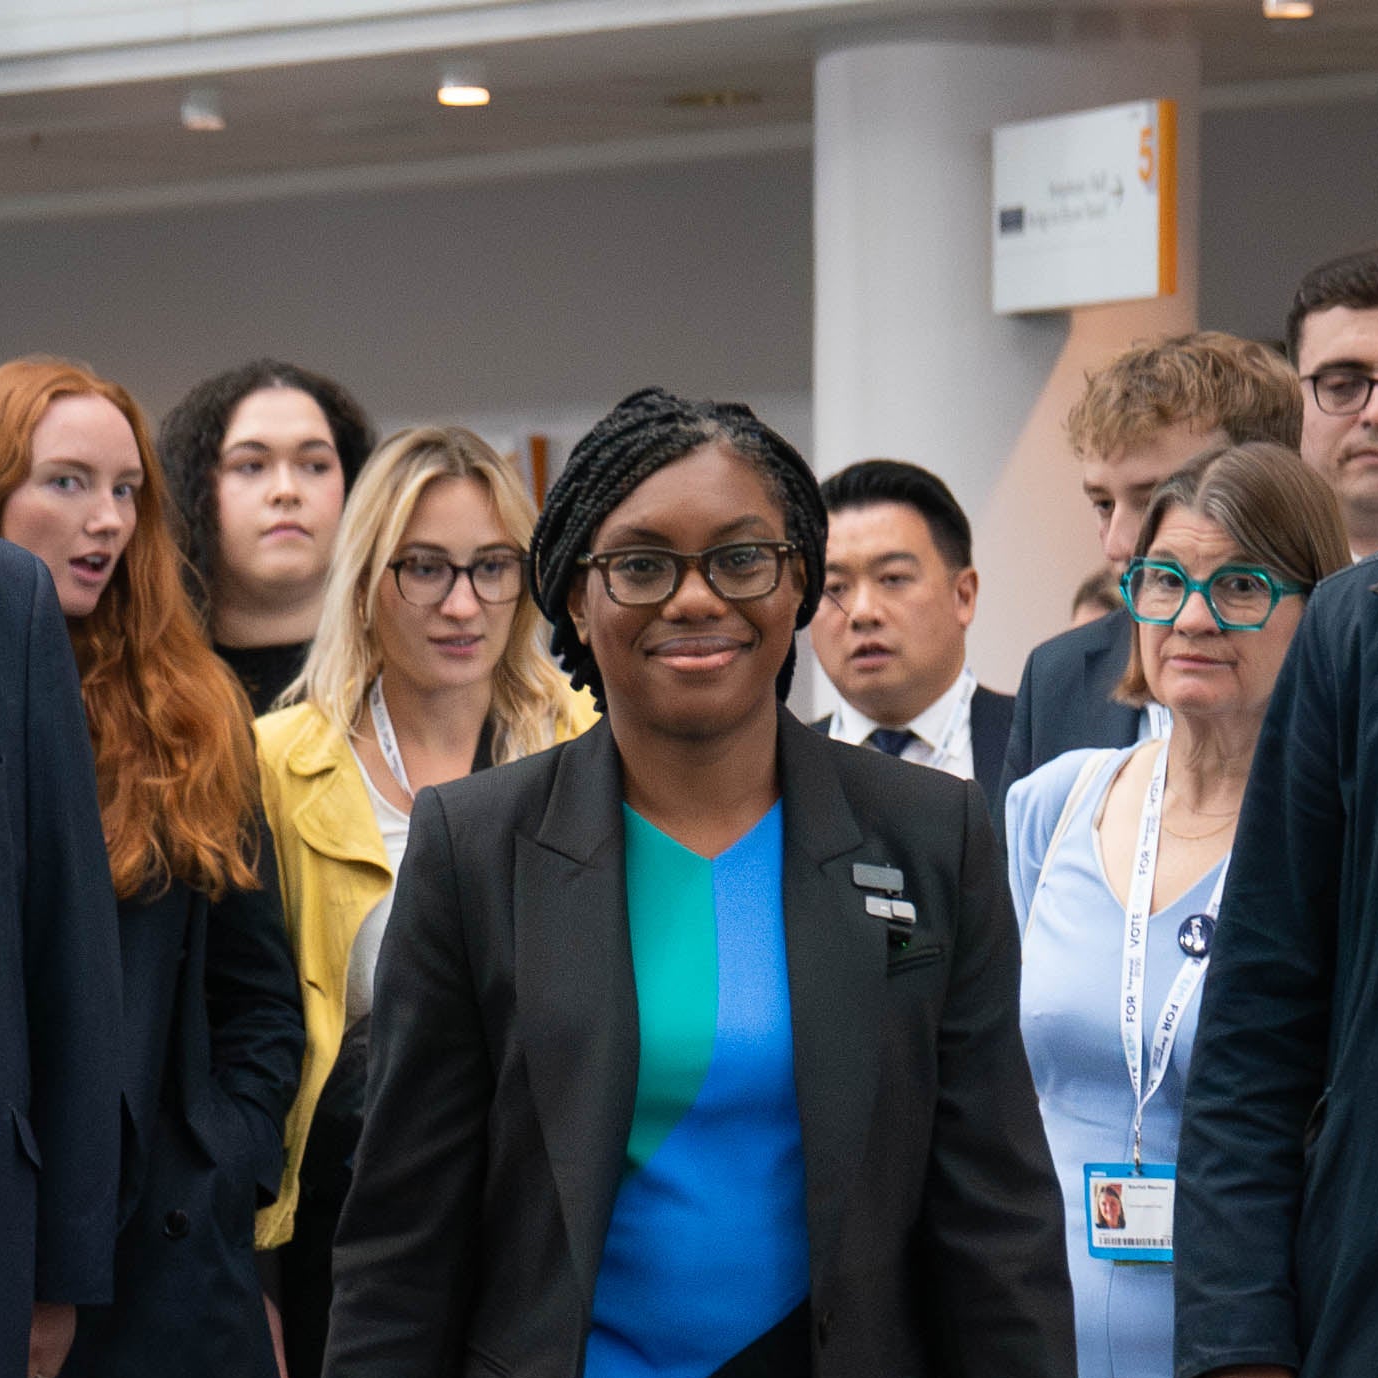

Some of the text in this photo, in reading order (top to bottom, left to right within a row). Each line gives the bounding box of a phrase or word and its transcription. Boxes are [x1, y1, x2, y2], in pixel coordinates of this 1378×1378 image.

[1139, 126, 1153, 181] 5
[1130, 912, 1142, 948] VOTE
[1138, 850, 1150, 876] FOR
[1126, 996, 1136, 1023] FOR
[1162, 1003, 1179, 1032] FOR
